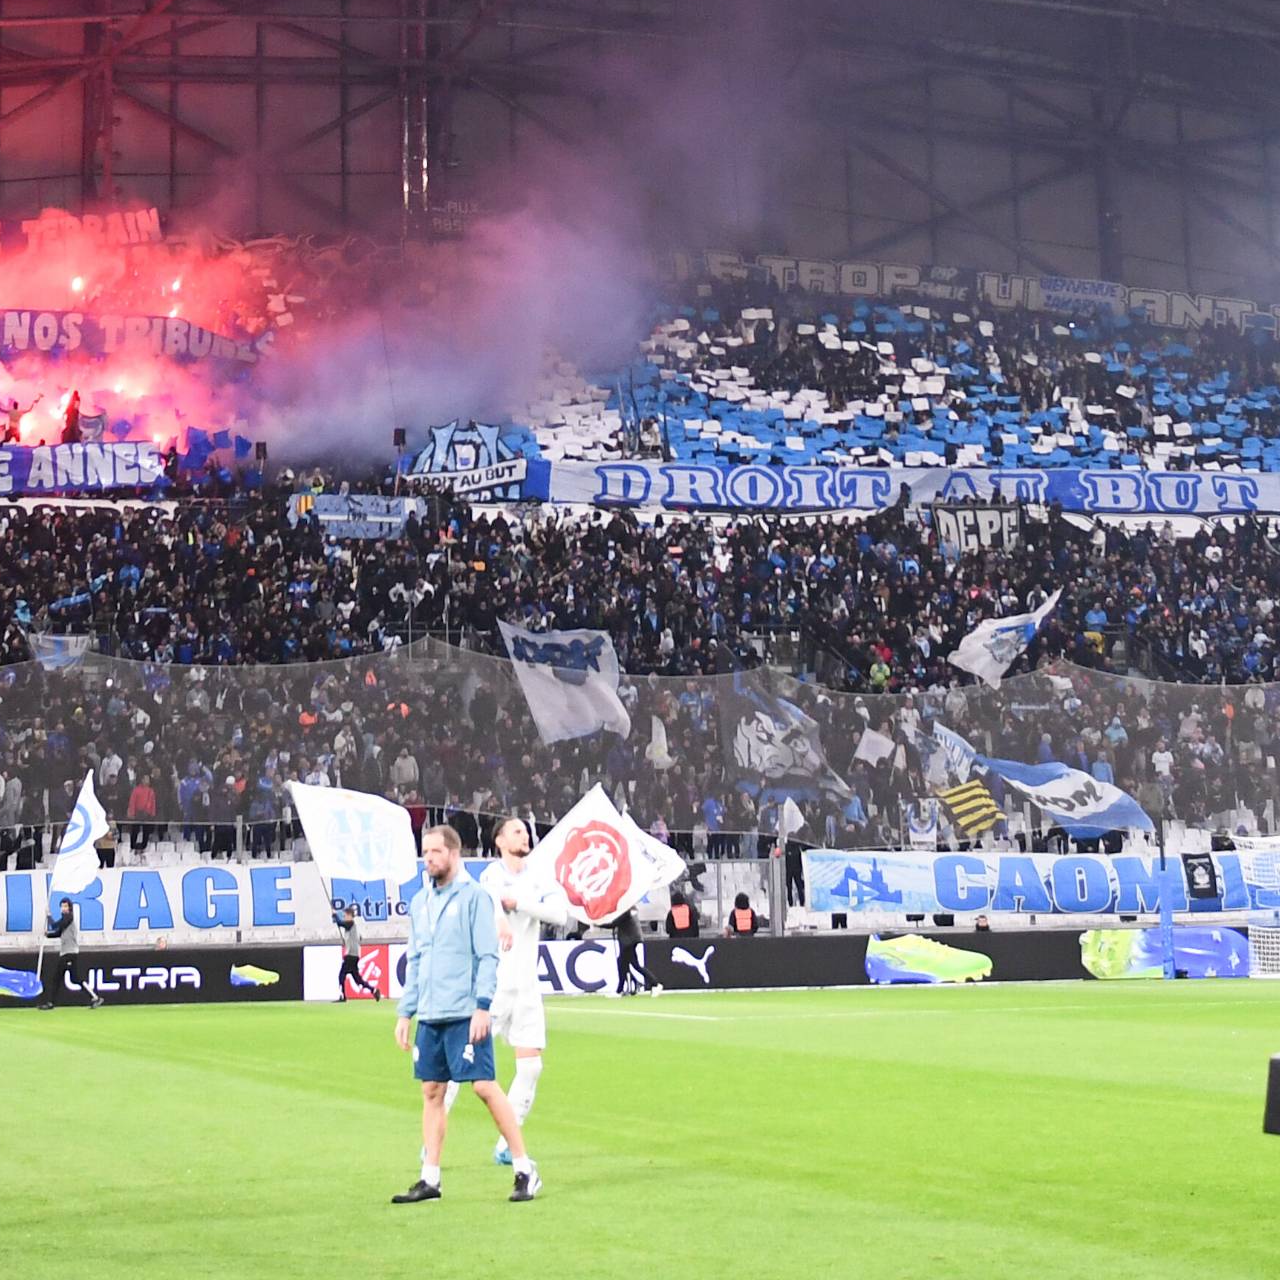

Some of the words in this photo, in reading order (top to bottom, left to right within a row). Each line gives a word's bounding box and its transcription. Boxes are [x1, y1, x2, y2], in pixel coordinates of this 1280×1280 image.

[3, 311, 85, 351] NOS
[27, 442, 163, 488] ANNEE
[460, 472, 482, 487] AU
[485, 465, 517, 481] BUT
[595, 464, 892, 510] DROIT
[1081, 471, 1259, 512] BUT
[933, 854, 1180, 912] CAOM
[331, 891, 408, 917] Patric
[64, 966, 202, 992] ULTRA
